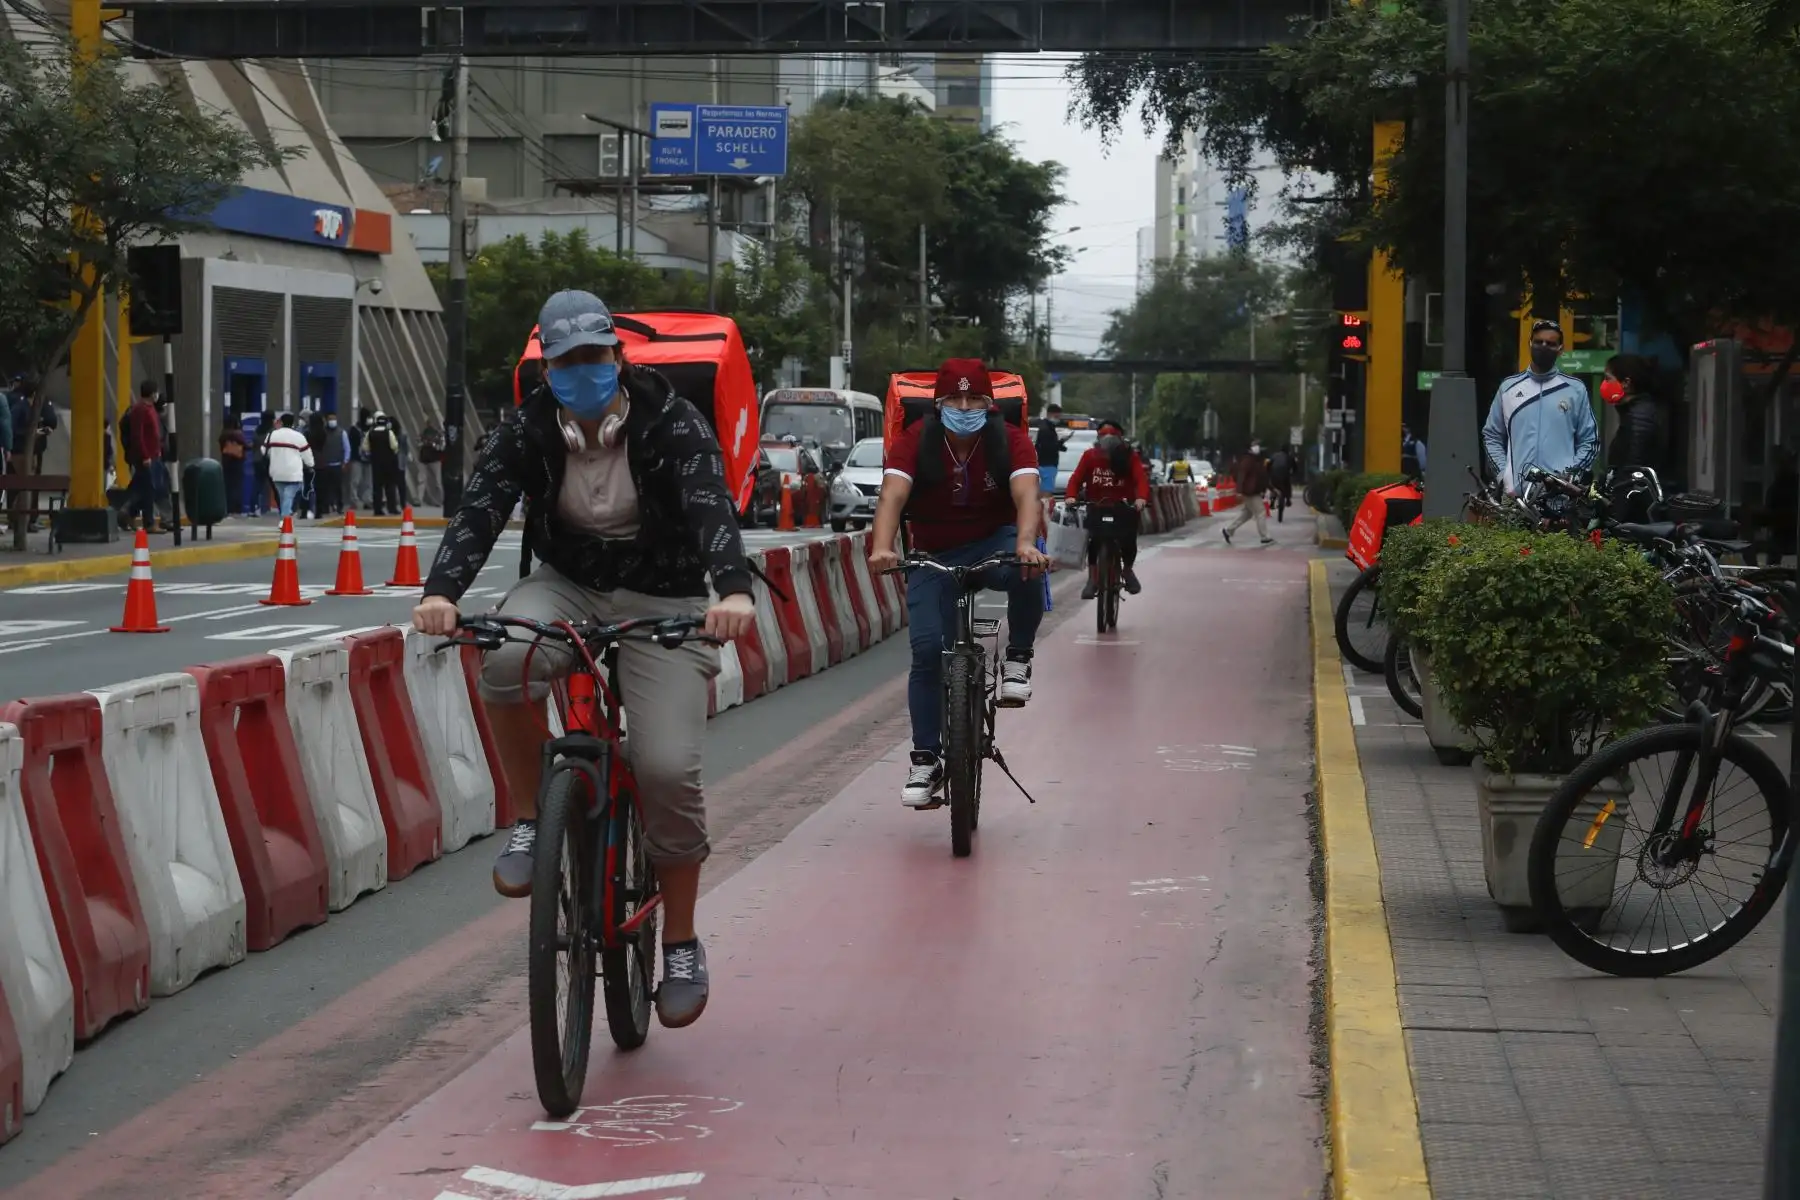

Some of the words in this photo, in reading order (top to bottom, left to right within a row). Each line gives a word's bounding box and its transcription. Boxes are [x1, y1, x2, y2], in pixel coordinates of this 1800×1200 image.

[708, 125, 777, 139] PARADERO
[662, 147, 682, 155] RUTA
[716, 142, 766, 154] SCHELL
[655, 156, 689, 166] TRONCAL
